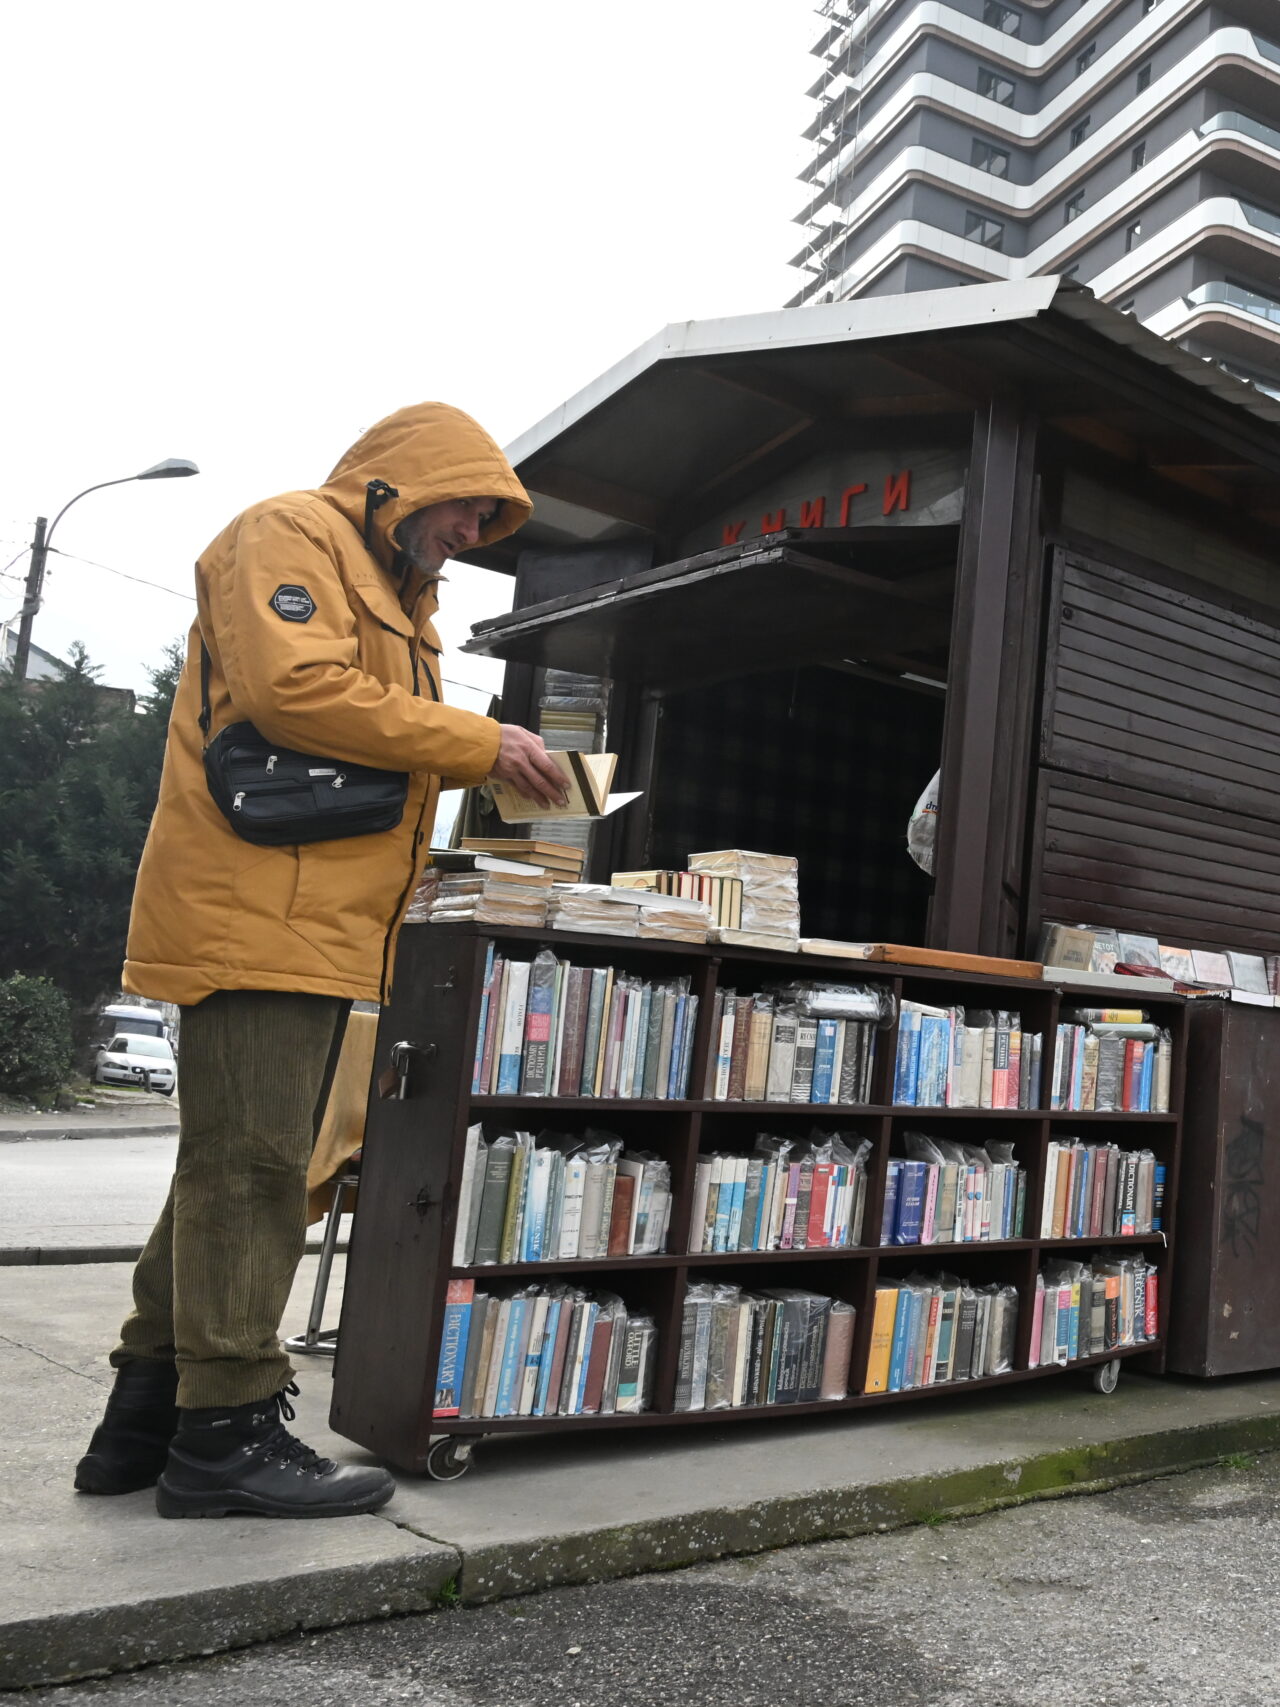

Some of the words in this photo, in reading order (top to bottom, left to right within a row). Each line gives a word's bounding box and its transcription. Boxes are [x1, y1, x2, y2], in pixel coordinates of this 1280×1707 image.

[526, 1044, 538, 1079] DICTIONARY
[535, 1044, 547, 1079] РЕЧНИК
[1126, 1164, 1136, 1210] DICTIONARY
[441, 1314, 462, 1385] DICTIONARY
[625, 1331, 635, 1367] OXFORD
[632, 1331, 642, 1366] LITTLE
